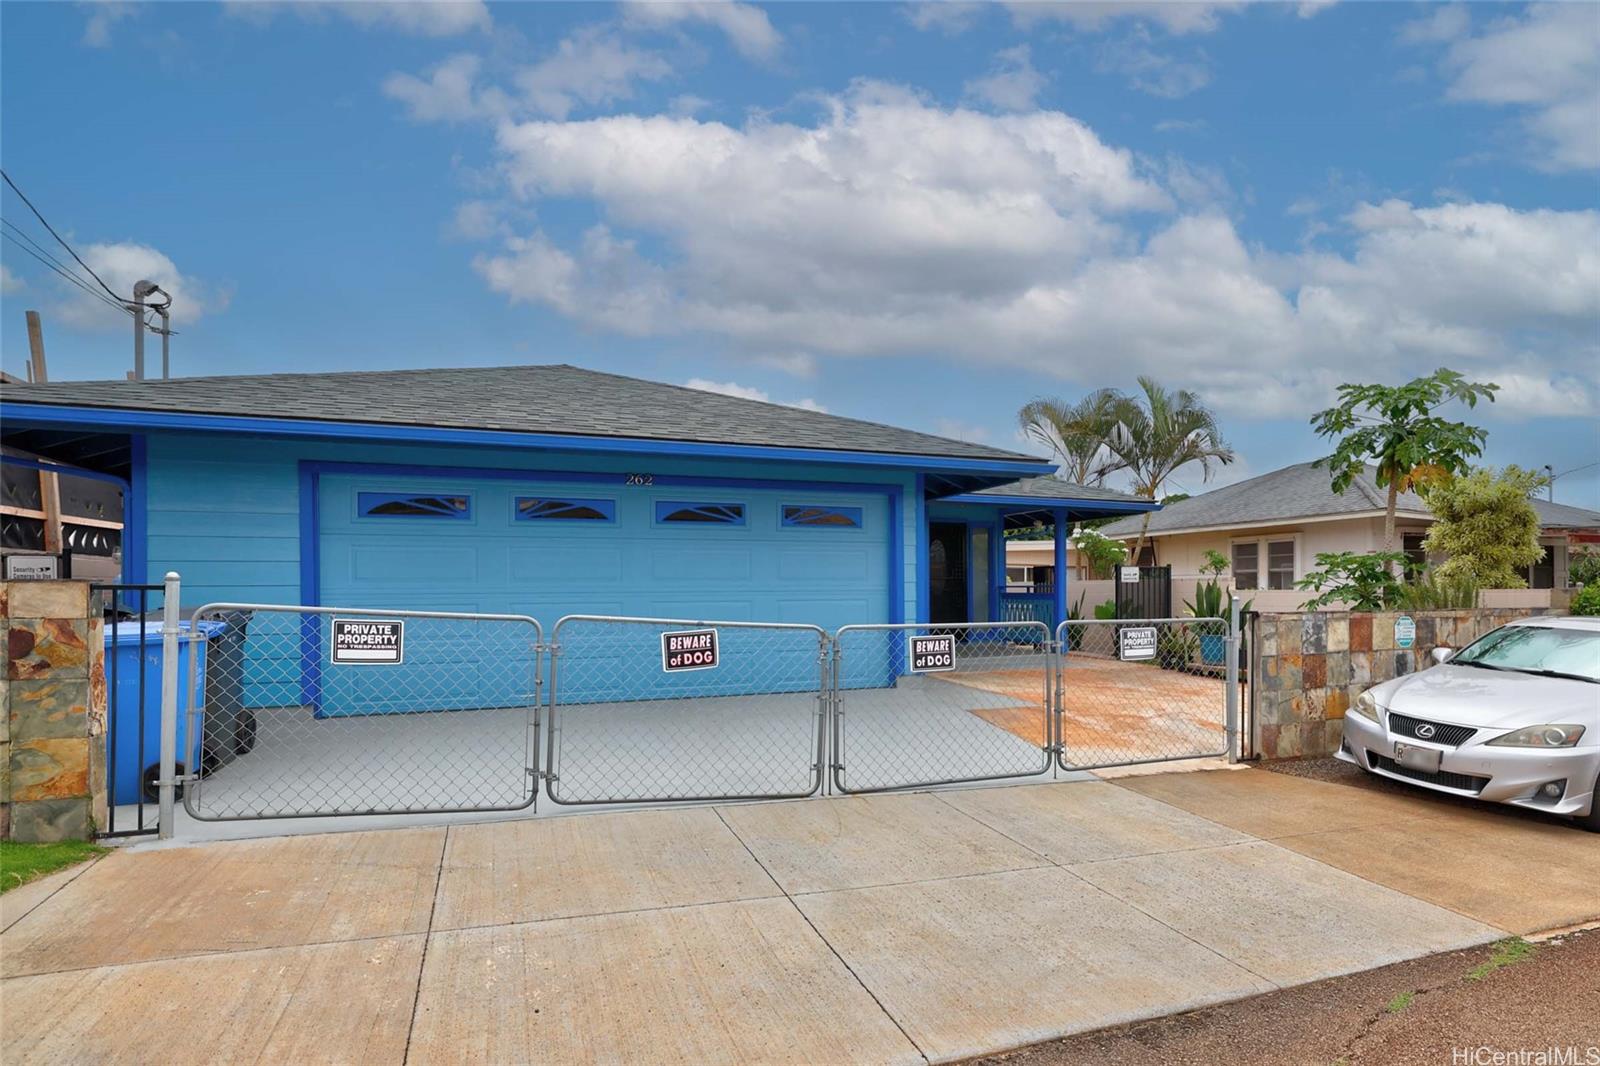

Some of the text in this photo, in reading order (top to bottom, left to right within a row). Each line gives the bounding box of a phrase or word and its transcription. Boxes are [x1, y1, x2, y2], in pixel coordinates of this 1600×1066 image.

[625, 475, 653, 486] 262
[344, 624, 392, 635] PRIVATE
[1127, 631, 1152, 639] PRIVATE
[337, 634, 398, 645] PROPERTY
[670, 635, 711, 650] BEWARE
[1124, 638, 1154, 646] PROPERTY
[916, 640, 949, 653] BEWARE
[670, 651, 713, 666] of DOG
[916, 655, 950, 667] of DOG
